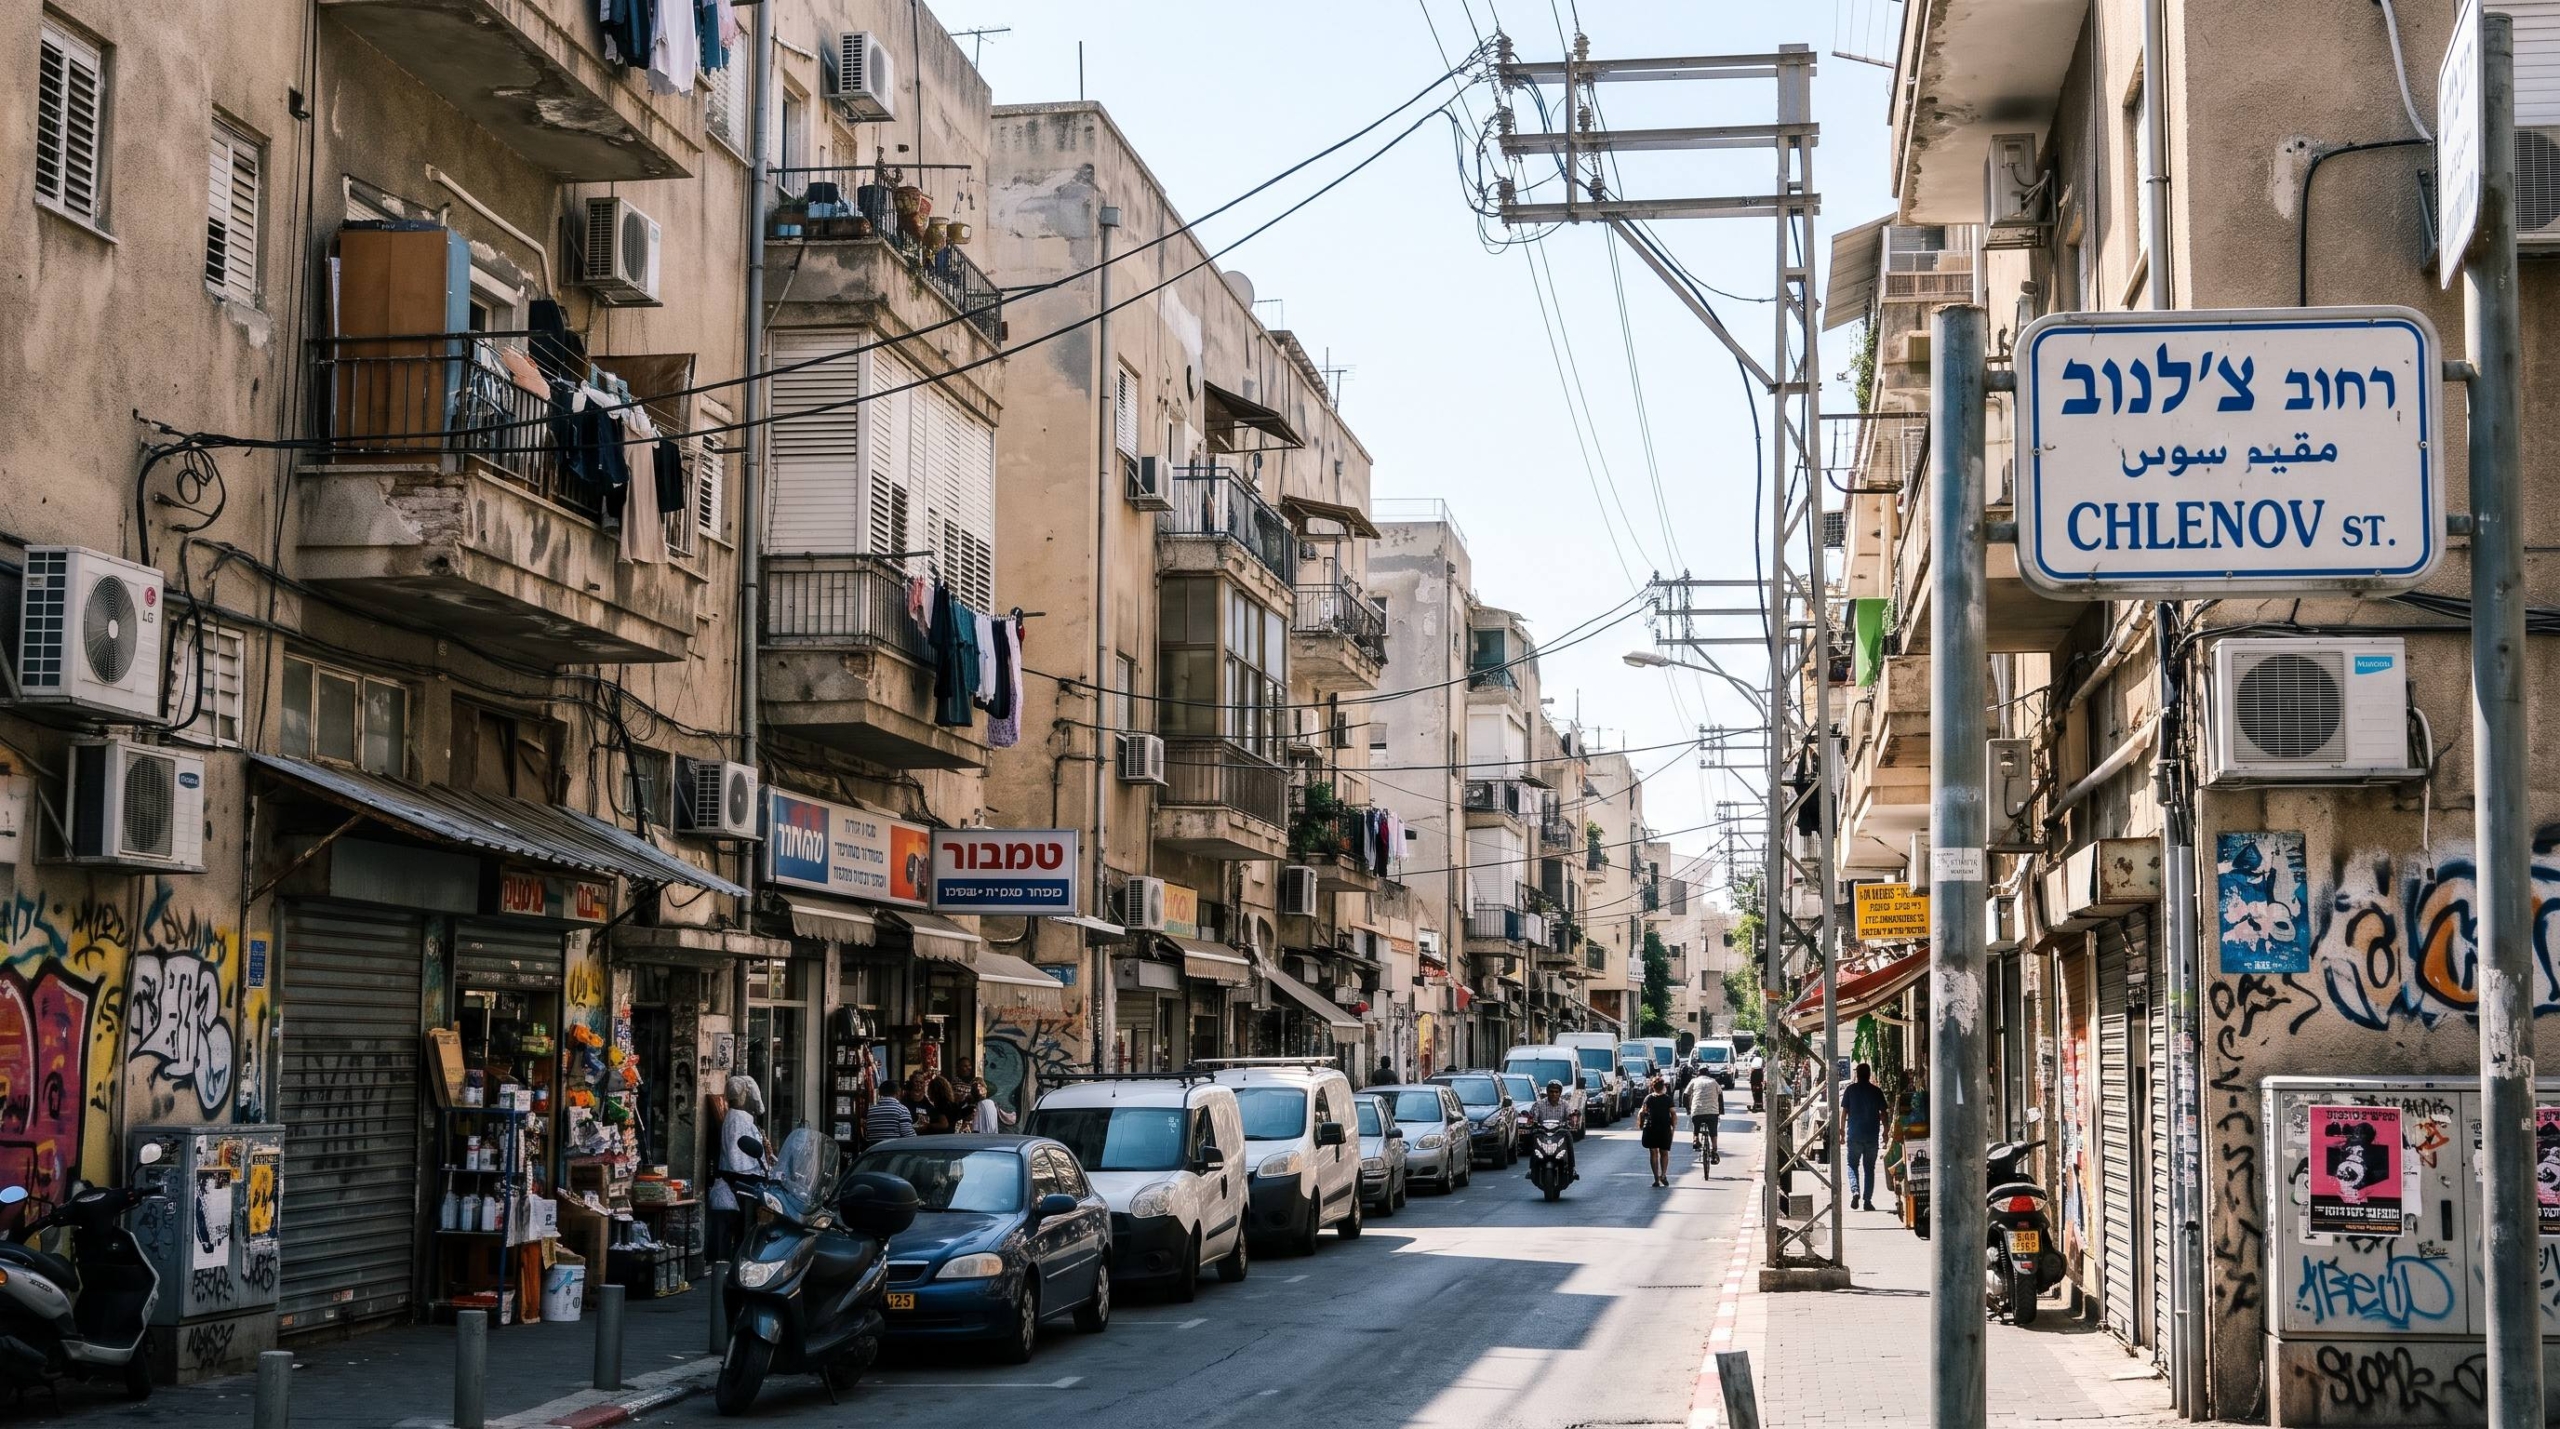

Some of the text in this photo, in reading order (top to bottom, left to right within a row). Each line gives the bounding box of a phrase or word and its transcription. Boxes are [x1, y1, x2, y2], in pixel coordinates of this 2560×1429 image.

[2284, 366, 2396, 411] רחוב
[2244, 431, 2338, 474] مقيم
[2066, 499, 2396, 551] CHLENOV ST.
[142, 610, 154, 623] LG
[942, 842, 1065, 870] טמבור
